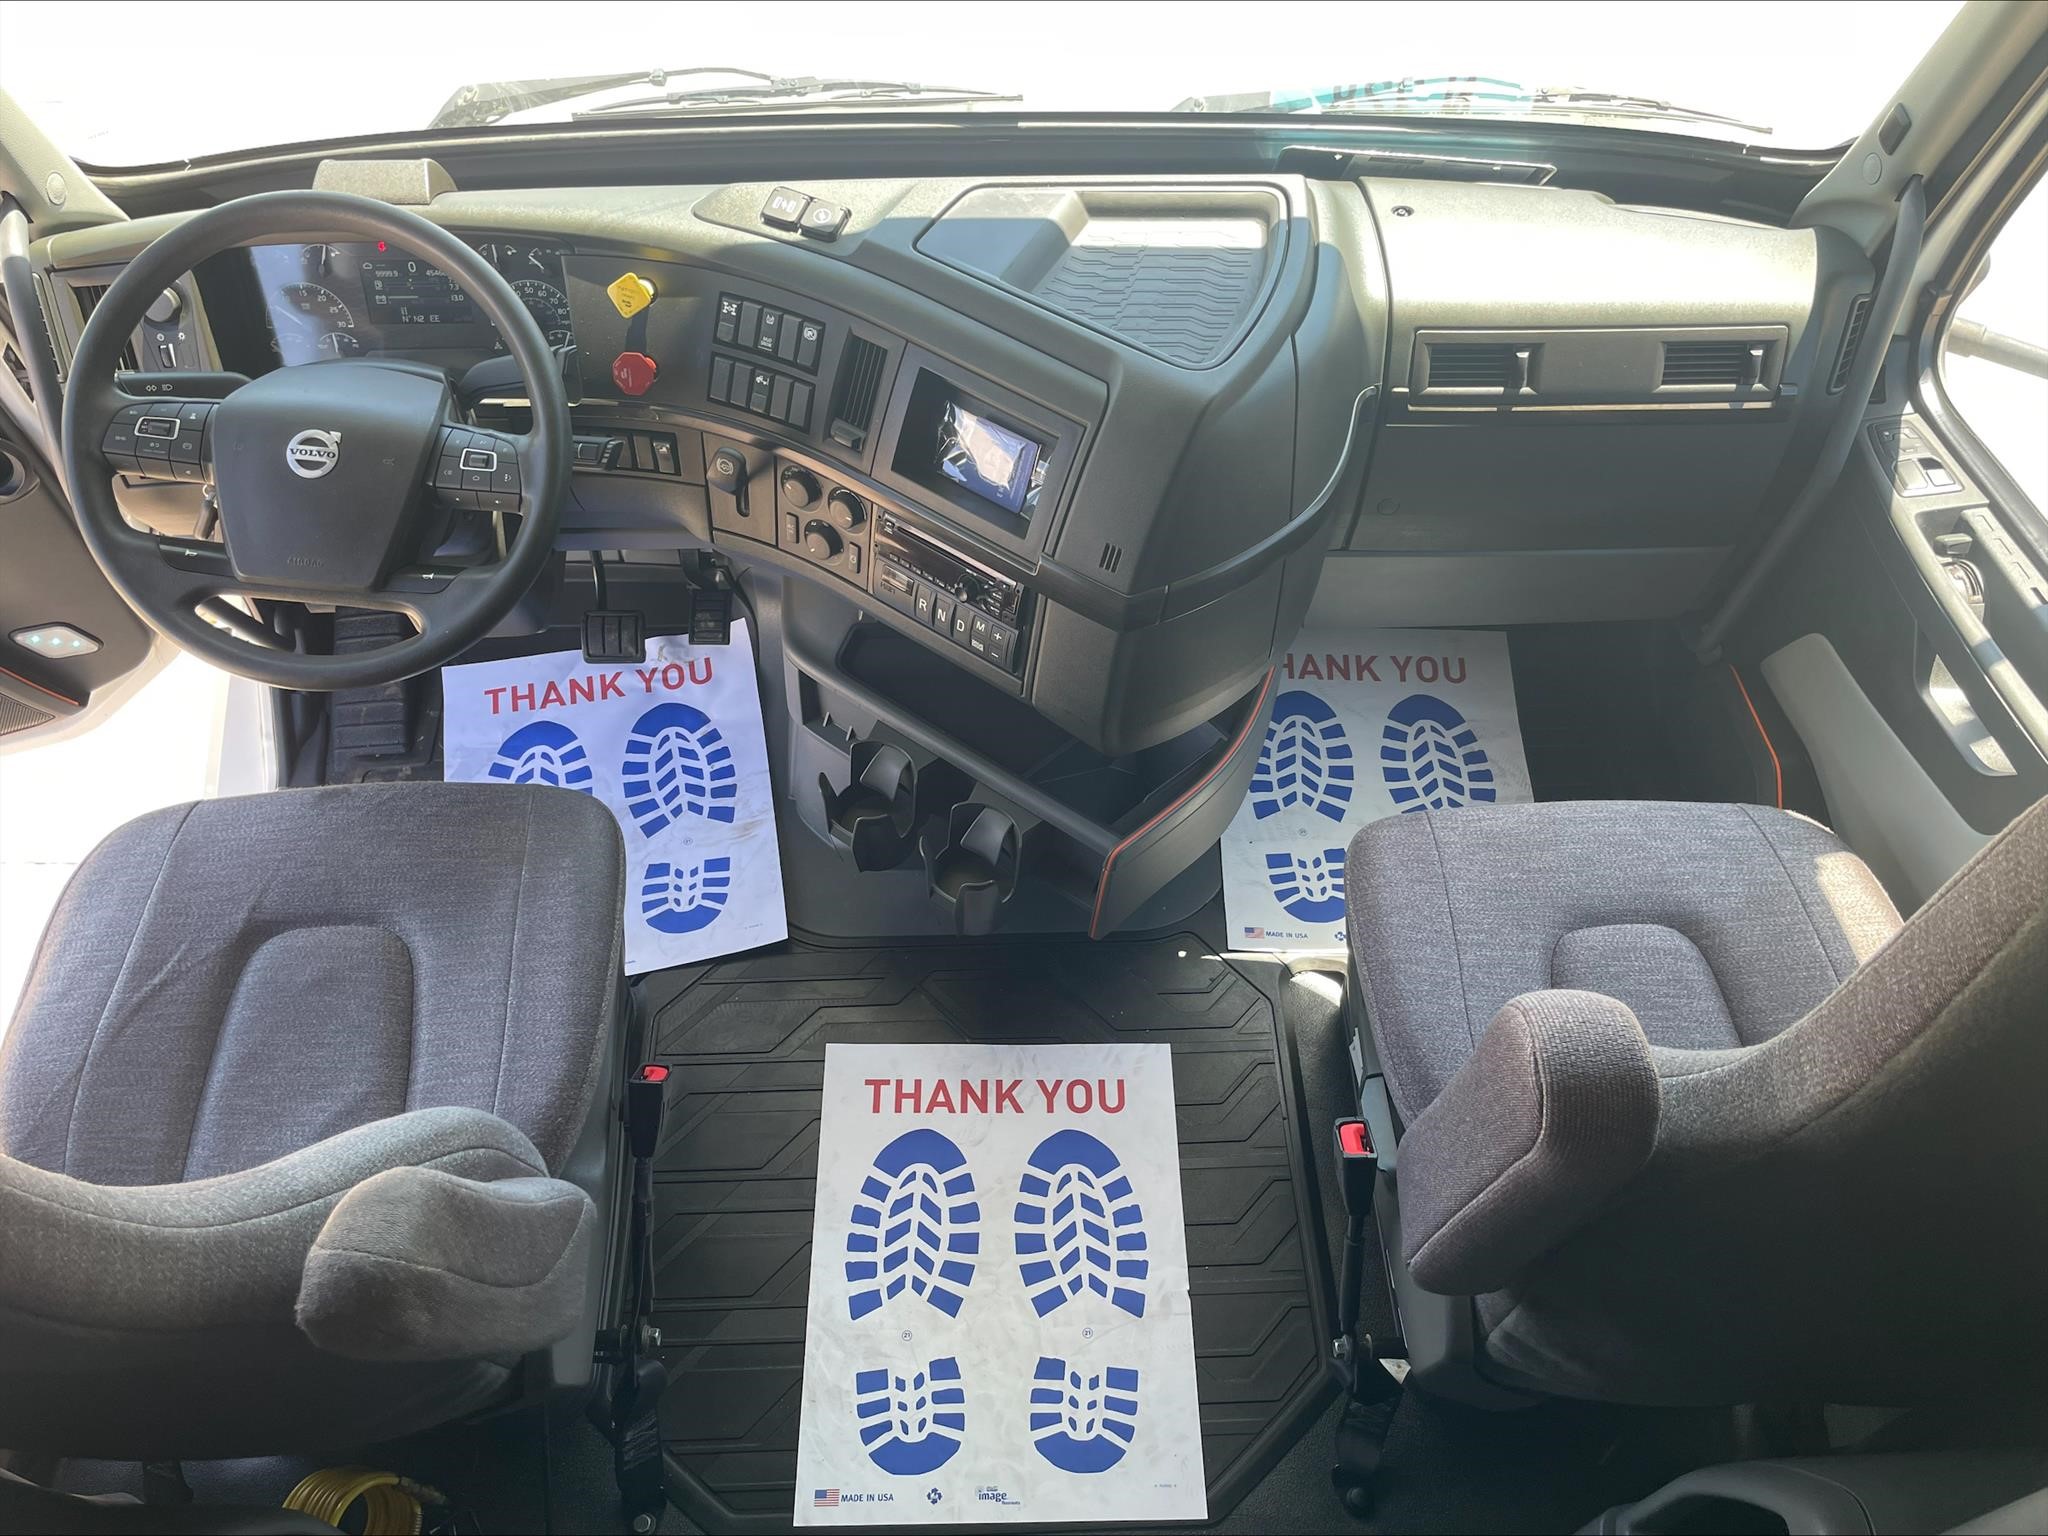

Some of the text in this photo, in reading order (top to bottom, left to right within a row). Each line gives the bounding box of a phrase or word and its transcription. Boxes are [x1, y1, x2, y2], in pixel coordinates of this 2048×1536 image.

[290, 448, 336, 459] VOLVO
[919, 598, 928, 611] R
[937, 609, 946, 622] N
[956, 620, 965, 632] D
[976, 621, 985, 632] M
[1283, 653, 1468, 684] HANK YOU
[484, 657, 714, 715] THANK YOU
[864, 1078, 1127, 1115] THANK YOU
[841, 1494, 864, 1502] MADE
[877, 1493, 894, 1501] USA
[978, 1491, 1007, 1502] image
